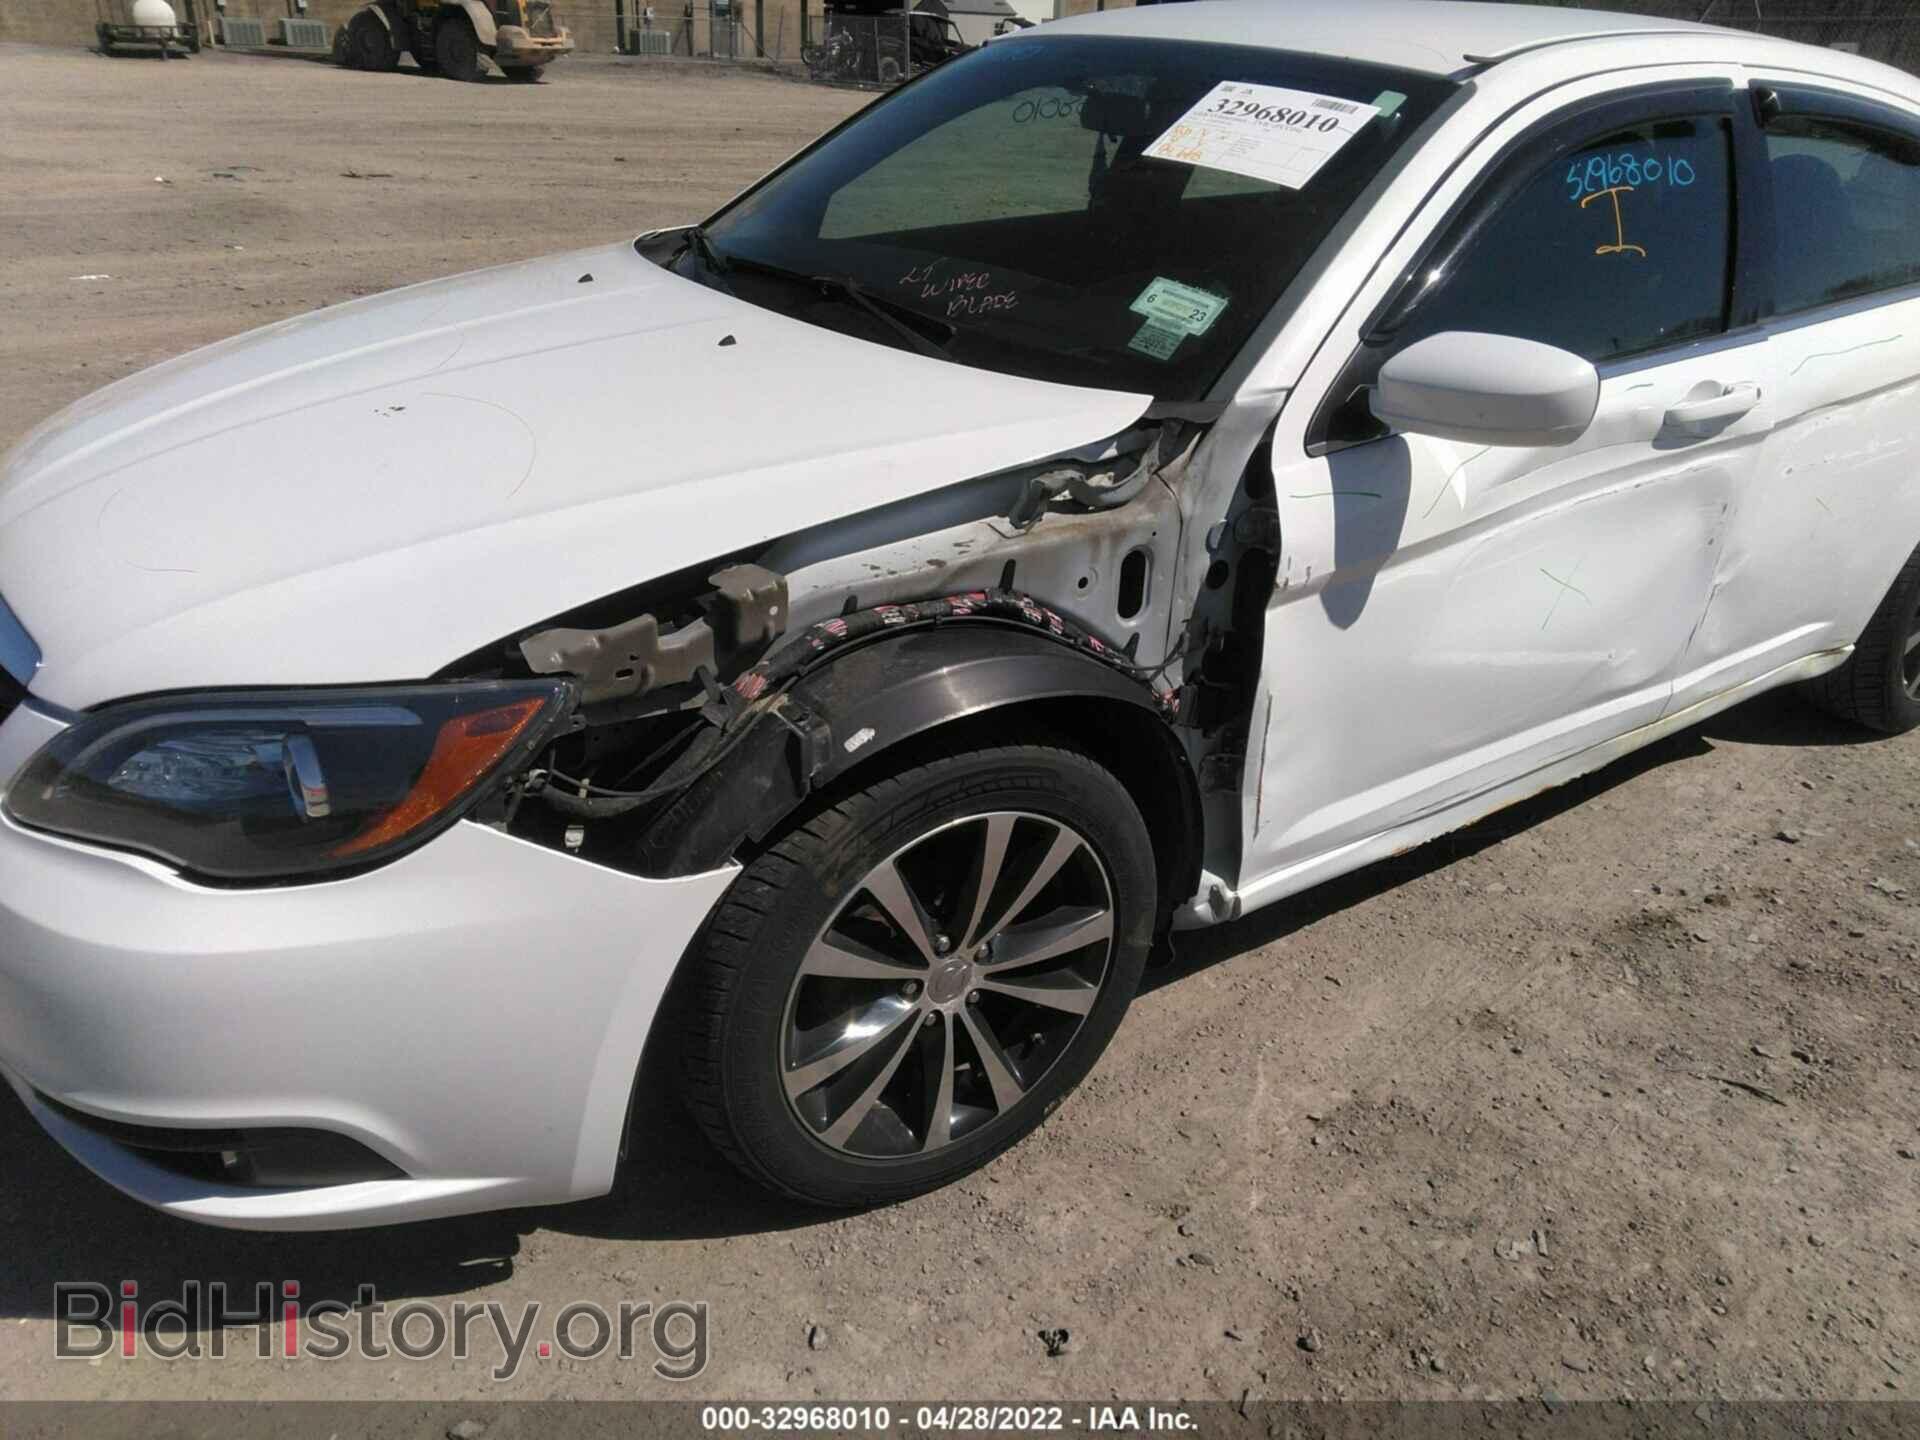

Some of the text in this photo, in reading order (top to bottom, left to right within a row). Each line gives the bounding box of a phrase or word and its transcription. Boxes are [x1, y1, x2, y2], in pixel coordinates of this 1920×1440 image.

[1207, 98, 1340, 133] 32968010
[1146, 293, 1157, 304] 6
[1189, 308, 1207, 322] 23
